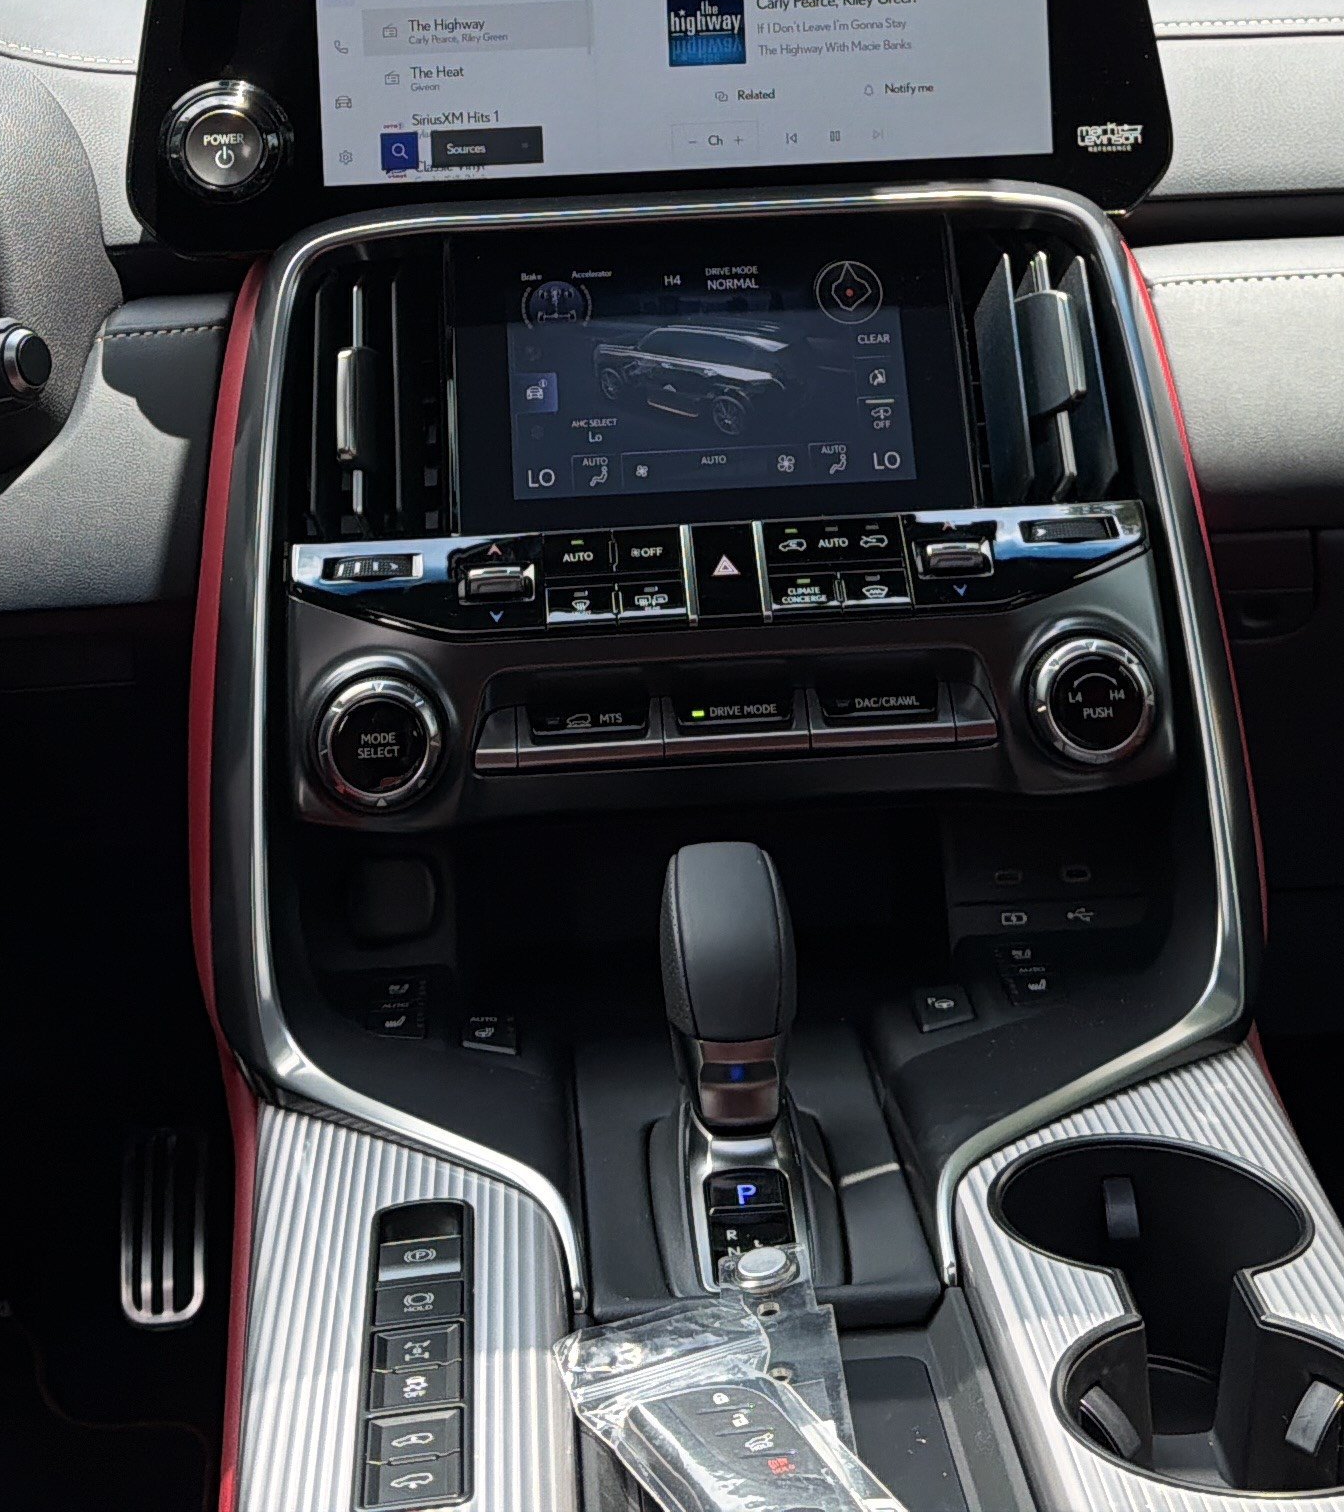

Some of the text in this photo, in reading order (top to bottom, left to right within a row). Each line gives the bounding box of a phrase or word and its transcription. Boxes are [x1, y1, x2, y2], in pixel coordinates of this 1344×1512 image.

[701, 0, 719, 15] the
[408, 18, 485, 32] The Highway
[670, 10, 742, 35] highway
[757, 22, 765, 34] If
[772, 21, 801, 34] Don't
[803, 21, 831, 33] Leave
[851, 19, 883, 30] Gonna
[885, 18, 907, 31] Stay
[409, 35, 429, 45] Carly
[461, 33, 481, 44] Riley
[483, 32, 509, 42] Green
[759, 44, 777, 56] The
[780, 43, 823, 57] Highway
[825, 42, 849, 53] With
[883, 39, 912, 51] Banks
[410, 66, 464, 79] The Heat
[737, 83, 934, 101] Related Notify me
[412, 112, 463, 127] SiriusXM
[467, 111, 491, 124] Hits
[494, 110, 500, 123] 1
[203, 133, 244, 146] POWER
[708, 135, 723, 146] Ch
[446, 142, 486, 155] Sources
[521, 268, 612, 281] Brake Accelerator
[705, 265, 758, 276] DRIVE MODE
[664, 274, 681, 287] H4
[707, 277, 759, 291] NORMAL
[857, 333, 891, 345] CLEAR
[590, 417, 618, 427] SELECT
[873, 419, 891, 430] OFF
[588, 431, 603, 443] Lo
[821, 444, 847, 455] AUTO
[582, 456, 608, 467] AUTO
[701, 454, 727, 465] AUTO
[873, 451, 901, 470] LO
[527, 468, 555, 488] LO
[818, 536, 849, 549] AUTO
[563, 550, 594, 562] AUTO
[641, 546, 663, 558] OFF
[787, 586, 821, 596] CLIMATE
[782, 594, 827, 604] CONCIERGE
[1068, 691, 1082, 704] L4
[1110, 689, 1125, 701] H4
[855, 695, 919, 709] DAC/CRAWL
[709, 703, 777, 717] DRIVE MODE
[1083, 706, 1113, 719] PUSH
[599, 712, 623, 724] MTS
[360, 732, 396, 745] MODE
[357, 745, 400, 759] SELECT
[737, 1184, 757, 1206] P
[726, 1229, 738, 1242] R
[403, 1303, 433, 1313] HOLD
[403, 1389, 426, 1399] OFF
